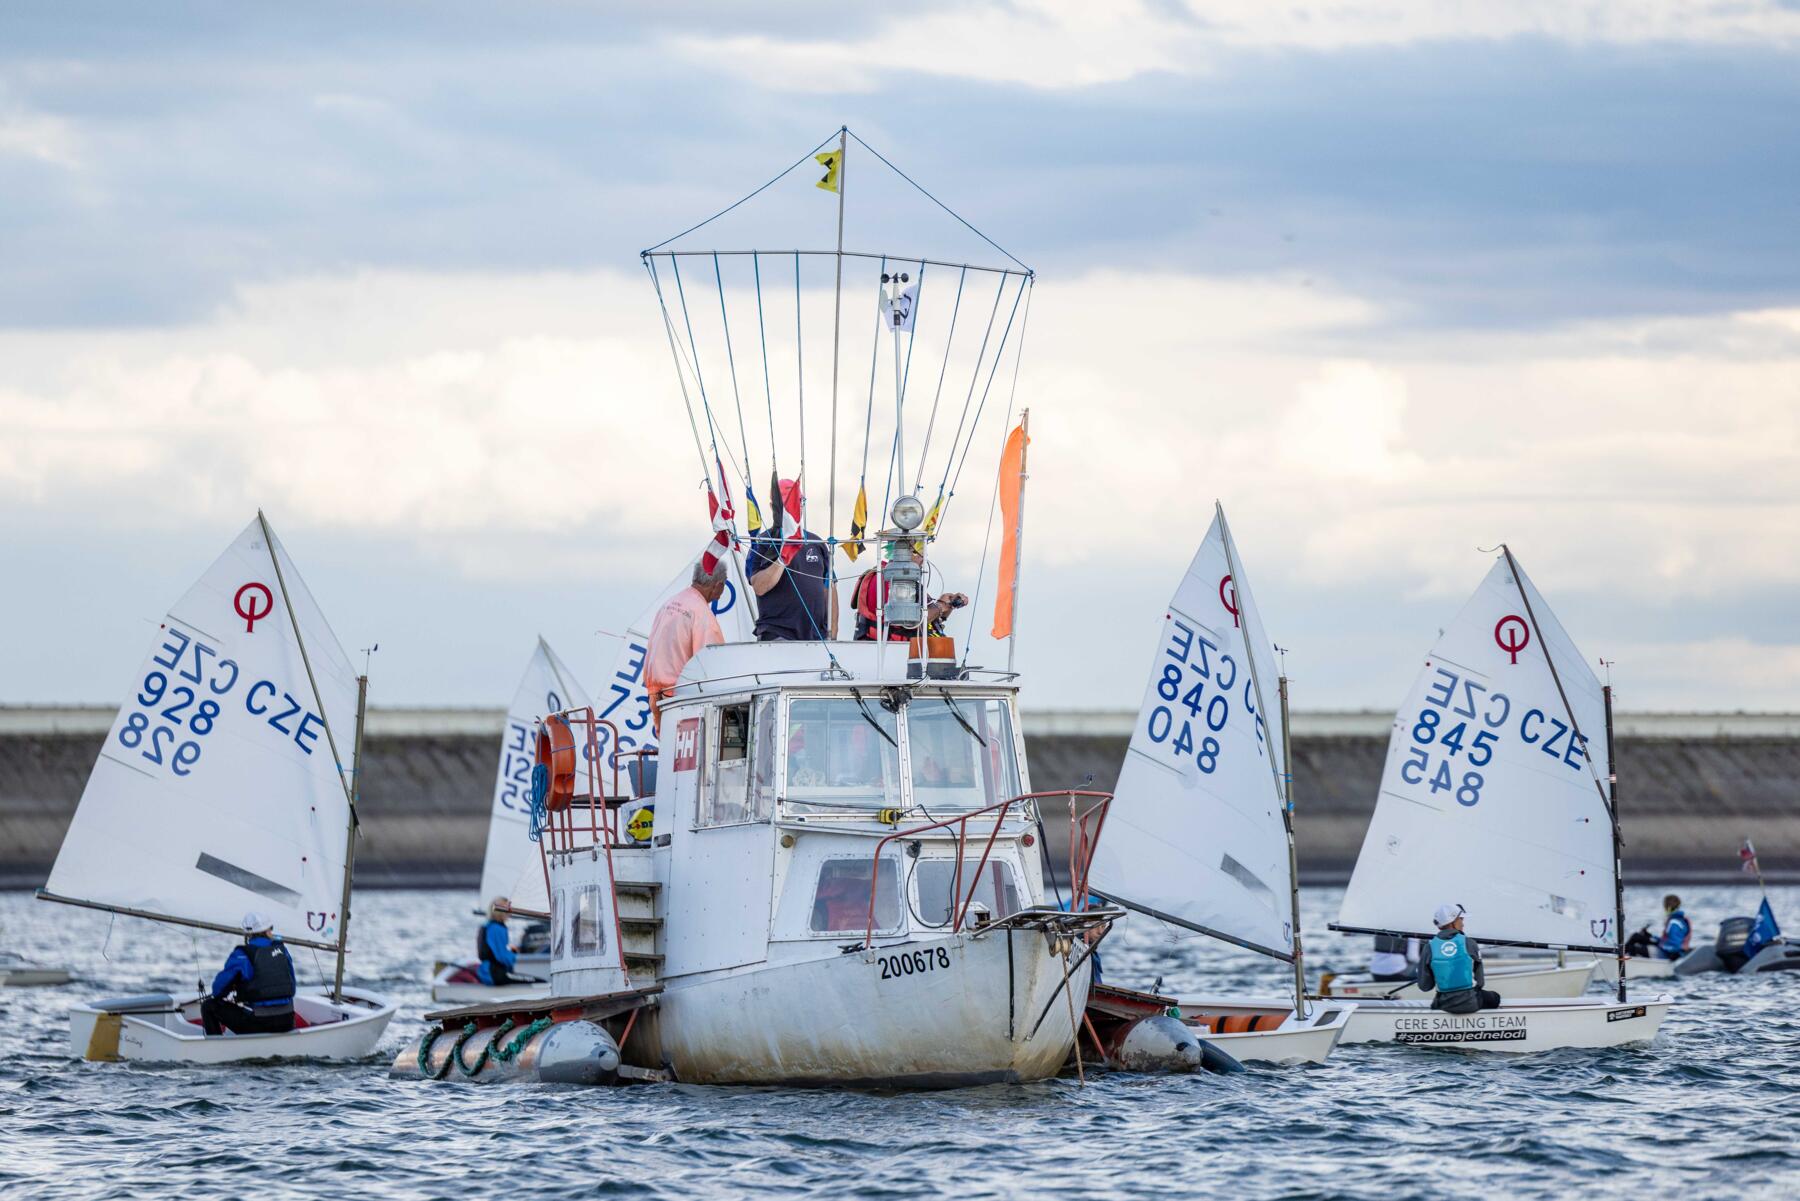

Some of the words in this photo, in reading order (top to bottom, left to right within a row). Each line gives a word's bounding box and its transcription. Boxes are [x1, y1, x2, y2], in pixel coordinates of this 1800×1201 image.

[137, 671, 221, 736] 928
[245, 680, 326, 756] CZE
[598, 683, 658, 740] 73
[1157, 663, 1229, 732] 840
[1412, 708, 1500, 767] 845
[1519, 708, 1589, 772] CZE
[877, 946, 951, 980] 200678
[1394, 1018, 1429, 1030] CERE
[1432, 1017, 1486, 1029] SAILING
[1490, 1015, 1527, 1028] TEAM
[1398, 1029, 1526, 1043] #spolunajednelodi
